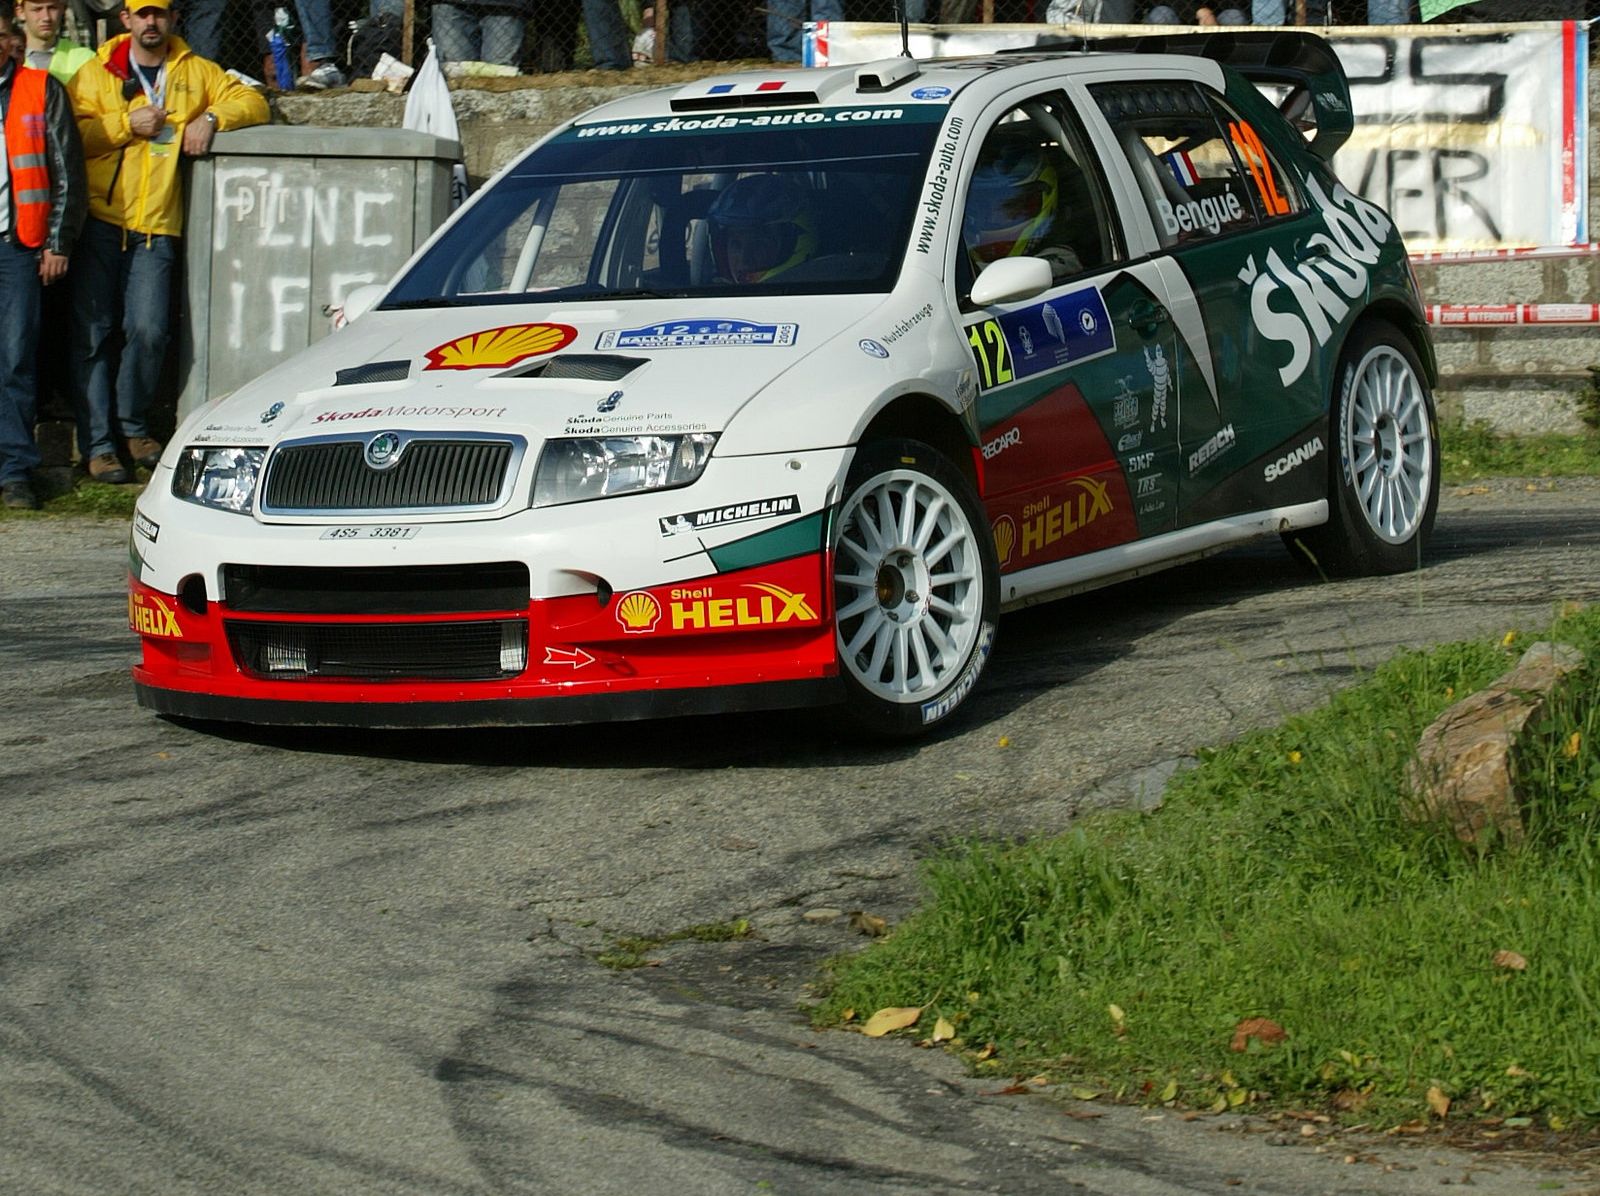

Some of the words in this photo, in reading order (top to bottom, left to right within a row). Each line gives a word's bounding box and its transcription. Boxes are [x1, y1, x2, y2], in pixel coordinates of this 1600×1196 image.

[917, 116, 964, 254] www.skoda-auto.com
[1228, 121, 1290, 216] 12
[214, 167, 394, 251] FLNC
[1155, 183, 1243, 235] Bengué
[1237, 171, 1392, 388] Škoda
[653, 325, 690, 336] 12
[778, 325, 791, 344] 2005
[882, 302, 934, 346] Nutzfahrzeuge
[968, 321, 1012, 388] 12
[646, 412, 673, 420] Parts
[646, 422, 707, 432] Accessories
[981, 427, 1021, 460] RECARO
[1128, 452, 1155, 473] SKF
[1263, 436, 1324, 483] SCANIA
[696, 498, 793, 526] MICHELIN
[1021, 478, 1114, 557] HELIX
[1023, 495, 1050, 520] Shell
[370, 527, 410, 538] 3381
[670, 587, 713, 600] Shell
[670, 584, 818, 630] HELIX
[134, 598, 183, 637] HELIX
